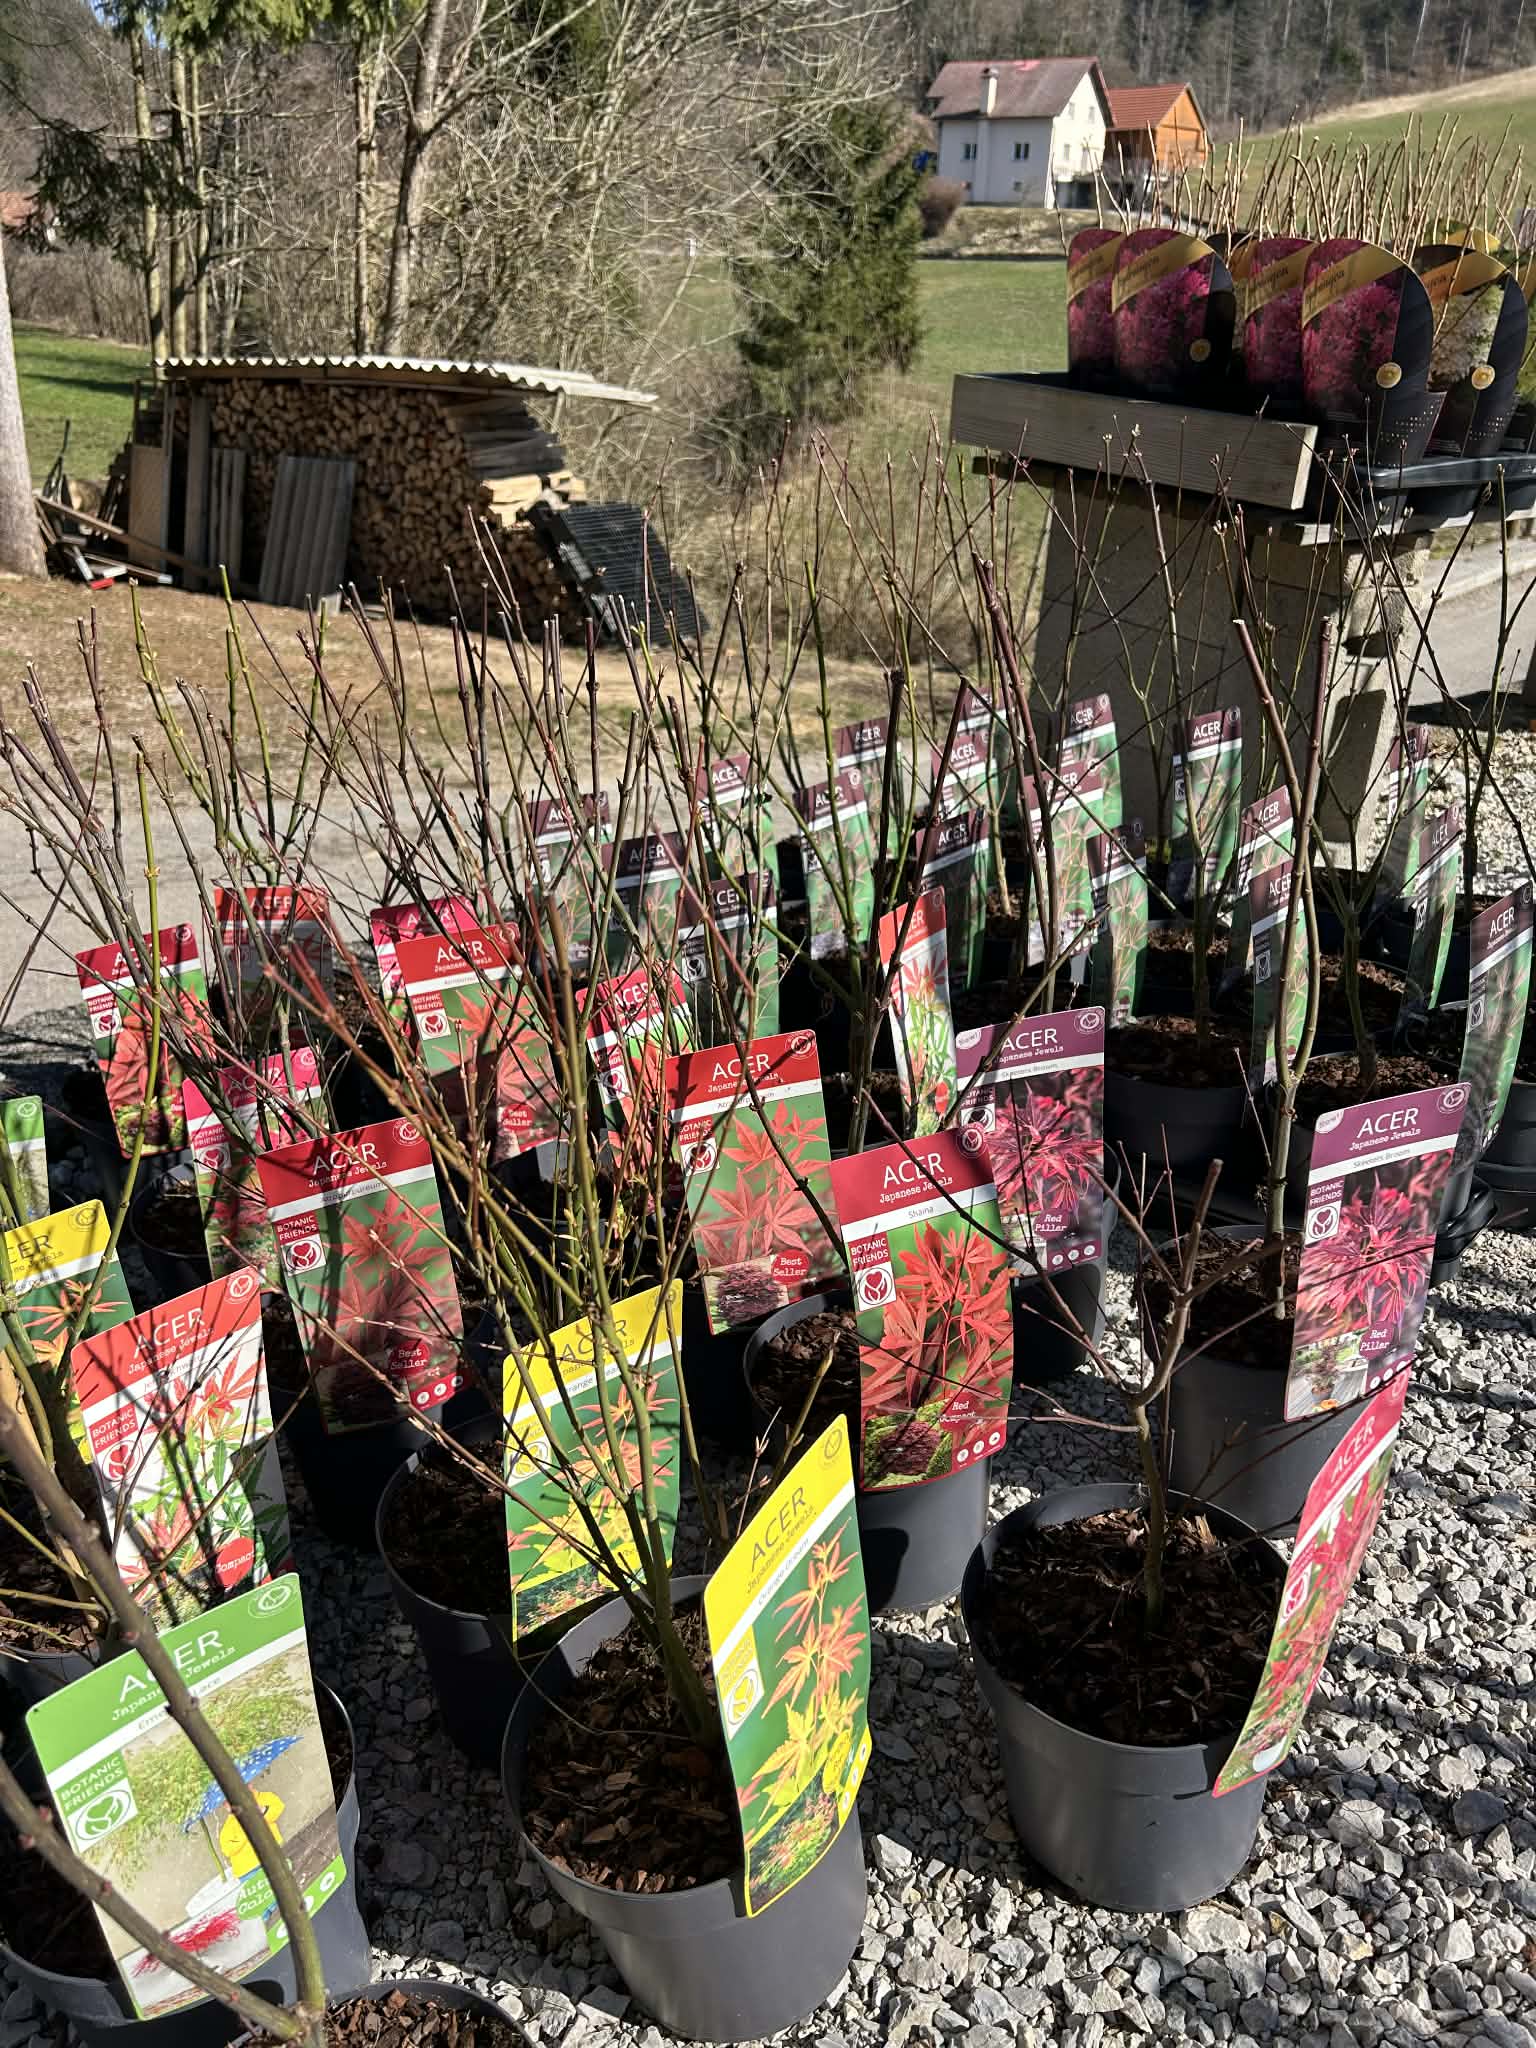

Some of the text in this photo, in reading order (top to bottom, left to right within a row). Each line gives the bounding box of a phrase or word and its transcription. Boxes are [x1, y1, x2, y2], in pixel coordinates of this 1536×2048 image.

[1193, 720, 1221, 741] ACER
[951, 744, 977, 764] ACER
[1489, 904, 1515, 937] ACER
[1000, 1027, 1059, 1054] ACER
[712, 1053, 771, 1082] ACER
[1355, 1106, 1419, 1139] ACER
[1348, 1127, 1421, 1152] Japanese Jewels
[879, 1185, 922, 1205] Japanese
[1309, 1189, 1342, 1207] FRIENDS
[1310, 1180, 1344, 1198] BOTANIC
[276, 1215, 315, 1234] BOTANIC
[1044, 1214, 1062, 1223] Red
[279, 1224, 318, 1242] FRIENDS
[850, 1237, 888, 1257] BOTANIC
[852, 1248, 890, 1268] FRIENDS
[773, 1267, 807, 1277] Seller
[780, 1257, 802, 1267] Best
[133, 1307, 206, 1359] ACER
[562, 1319, 627, 1361] ACR
[1370, 1329, 1387, 1339] Red
[951, 1400, 970, 1411] Red
[92, 1409, 134, 1438] BOTANIC
[94, 1420, 137, 1450] FRIENDS
[1330, 1415, 1376, 1483] ACER
[751, 1487, 806, 1573] ACER
[185, 1646, 236, 1678] Jewels
[61, 1756, 121, 1802] BOTANIC
[64, 1767, 124, 1812] FRIENDS
